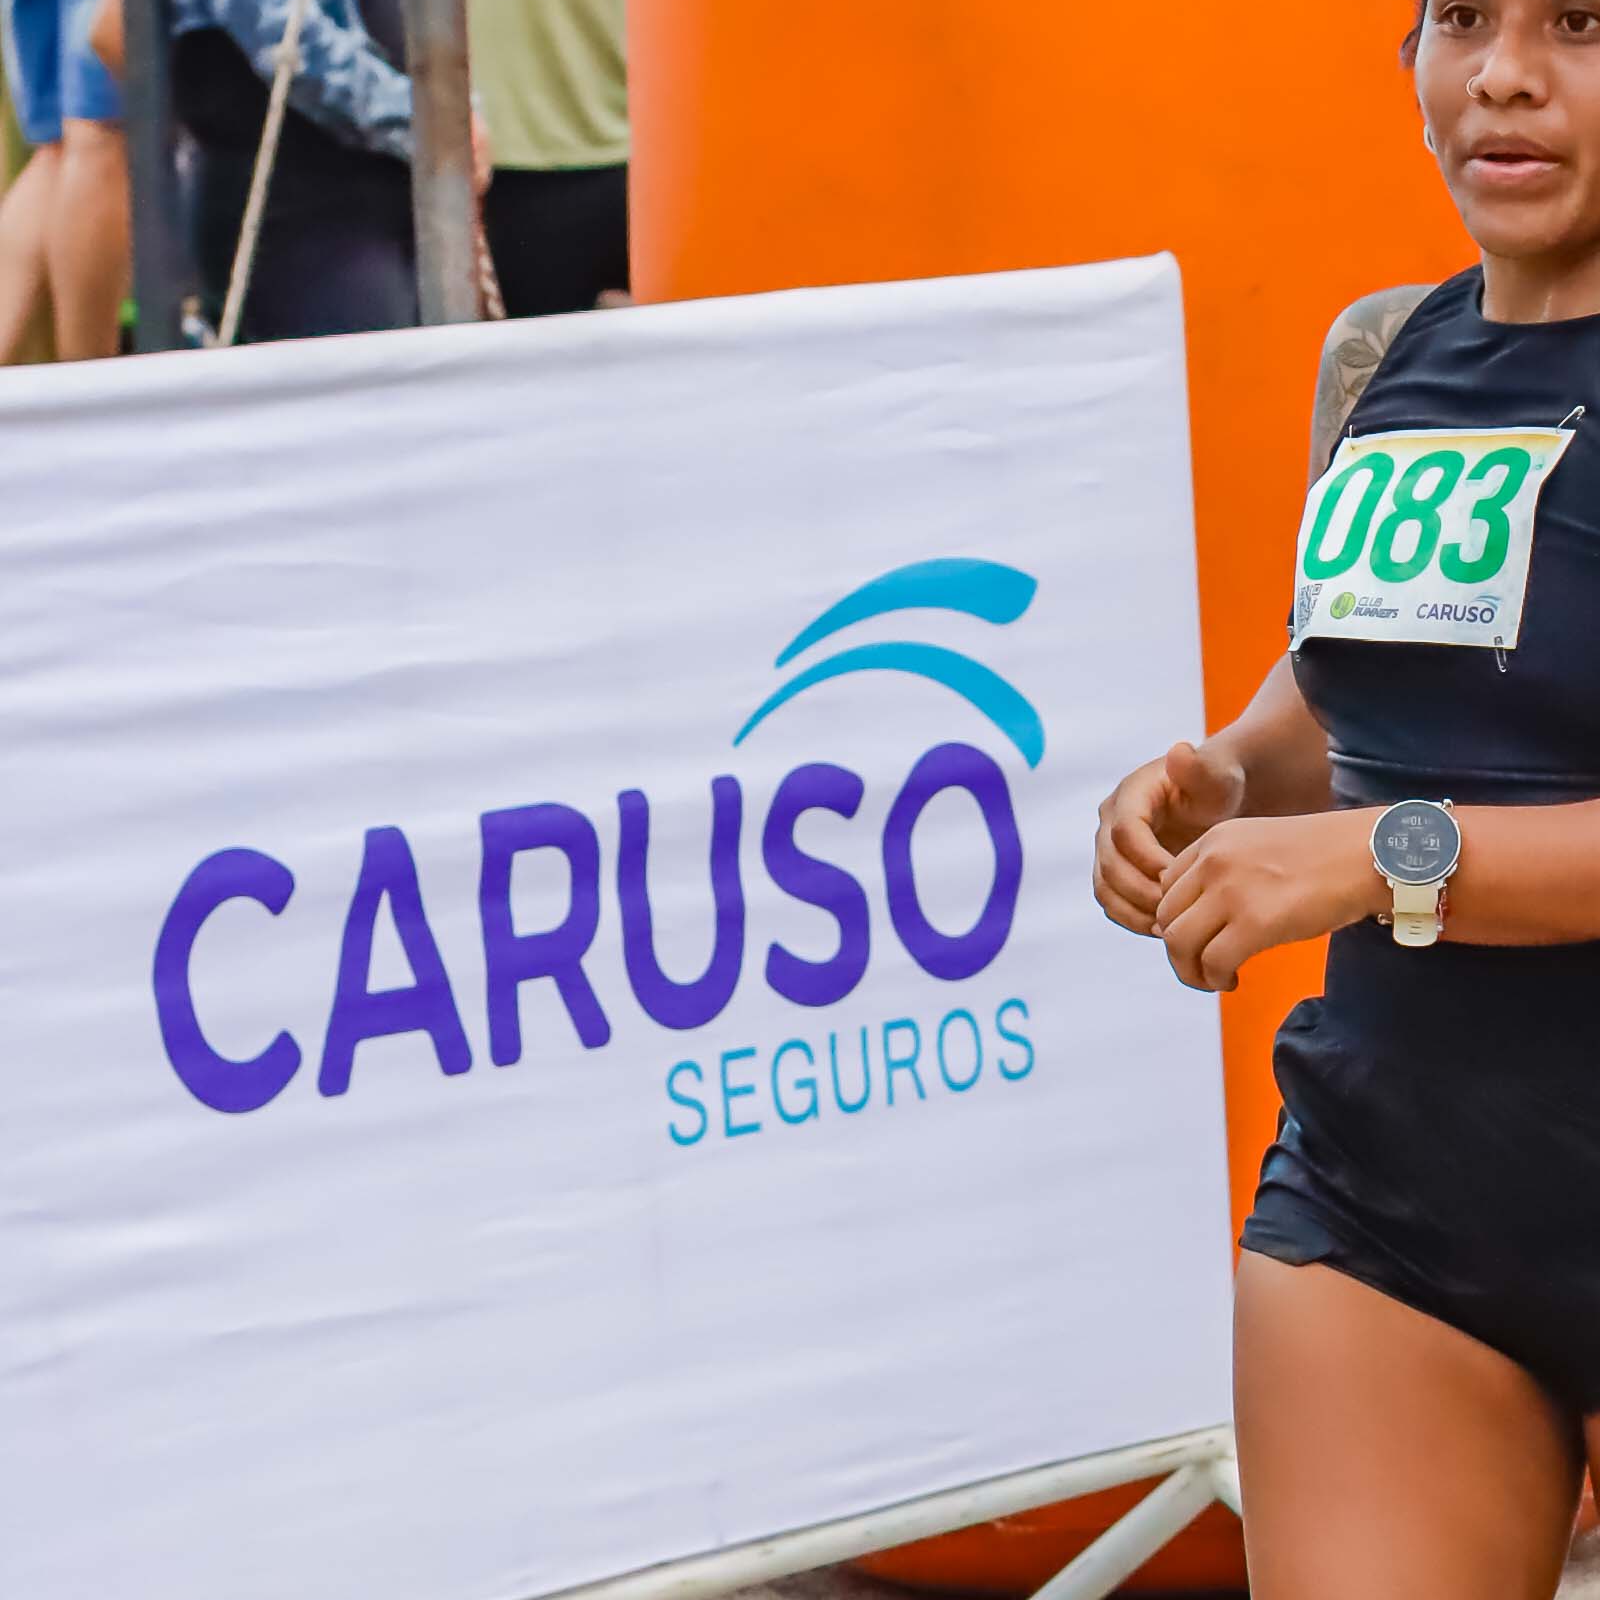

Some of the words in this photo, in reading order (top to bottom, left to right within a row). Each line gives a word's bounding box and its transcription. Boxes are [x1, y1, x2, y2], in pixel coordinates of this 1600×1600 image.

[1303, 447, 1531, 584] 083
[1358, 596, 1384, 607] CLUB
[1416, 603, 1495, 624] CARUSO
[152, 741, 1023, 1114] CARUSO
[665, 998, 1037, 1149] SEGUROS
